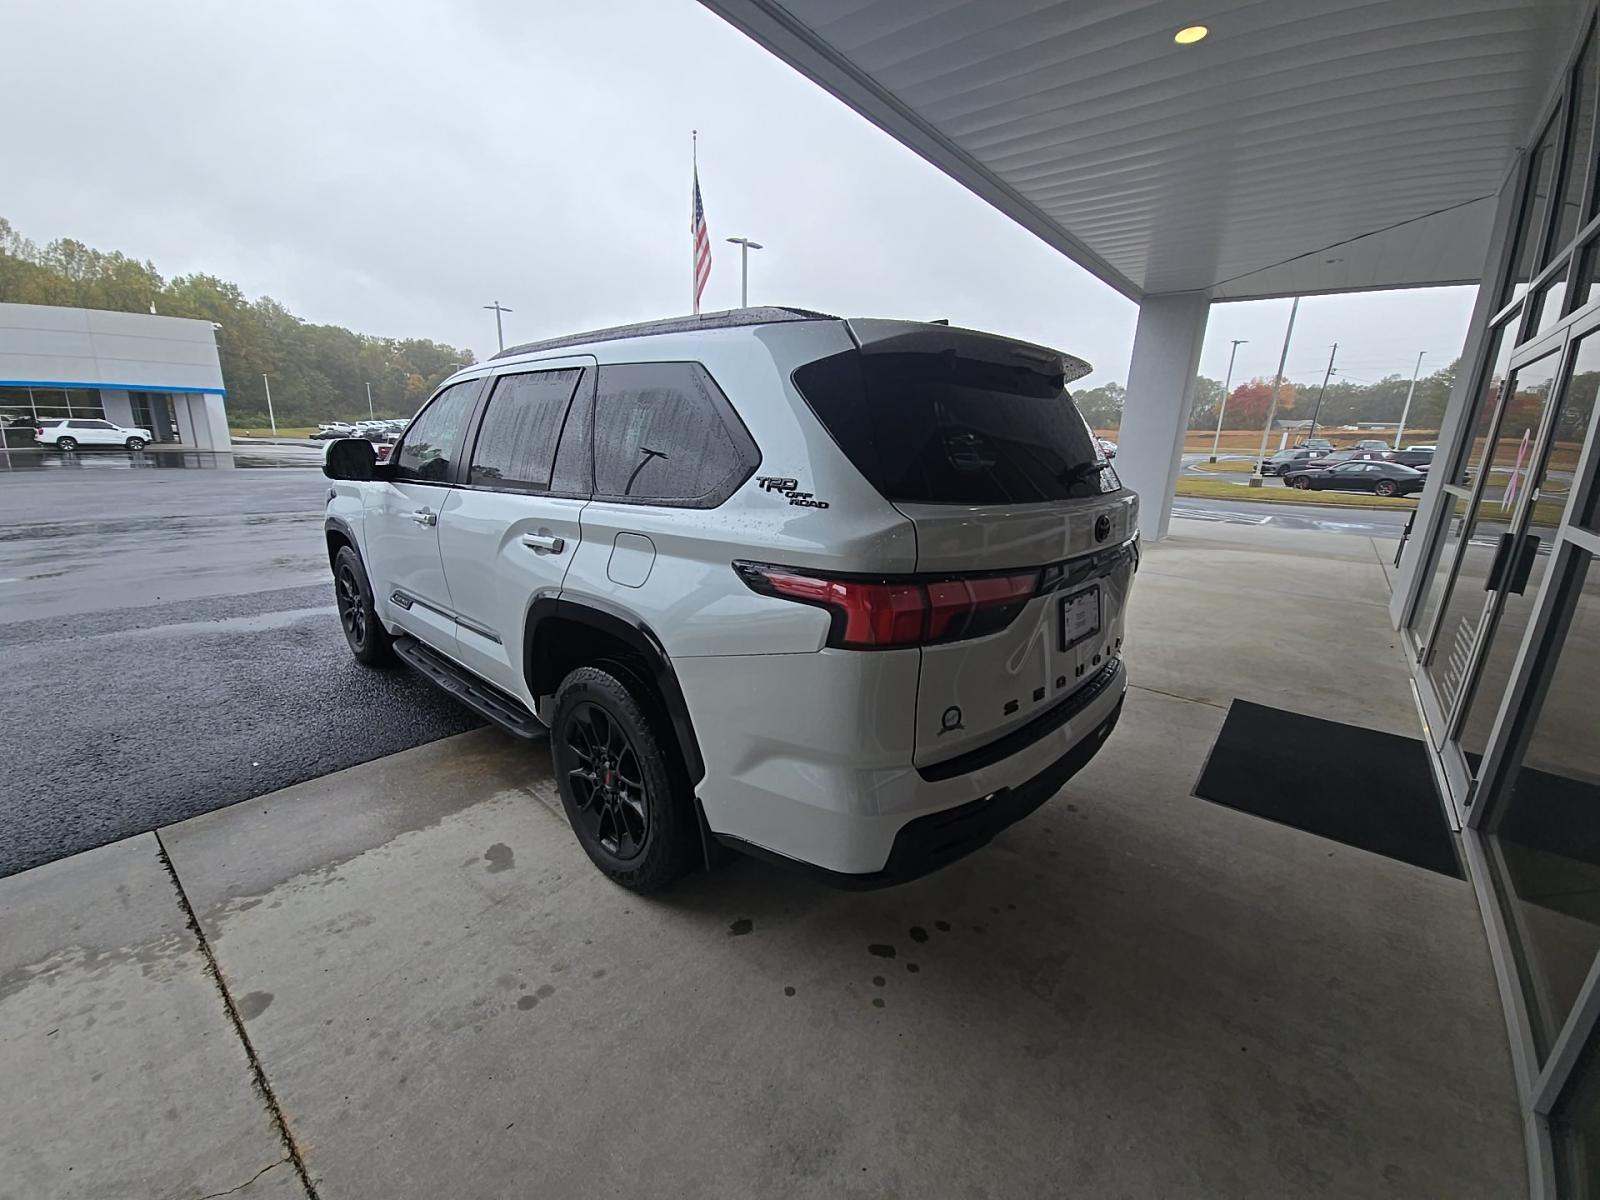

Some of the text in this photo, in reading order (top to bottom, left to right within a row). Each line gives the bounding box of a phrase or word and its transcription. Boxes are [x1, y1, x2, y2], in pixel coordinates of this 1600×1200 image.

[756, 476, 798, 493] TRD
[785, 491, 813, 499] OFF
[789, 499, 829, 509] ROAD
